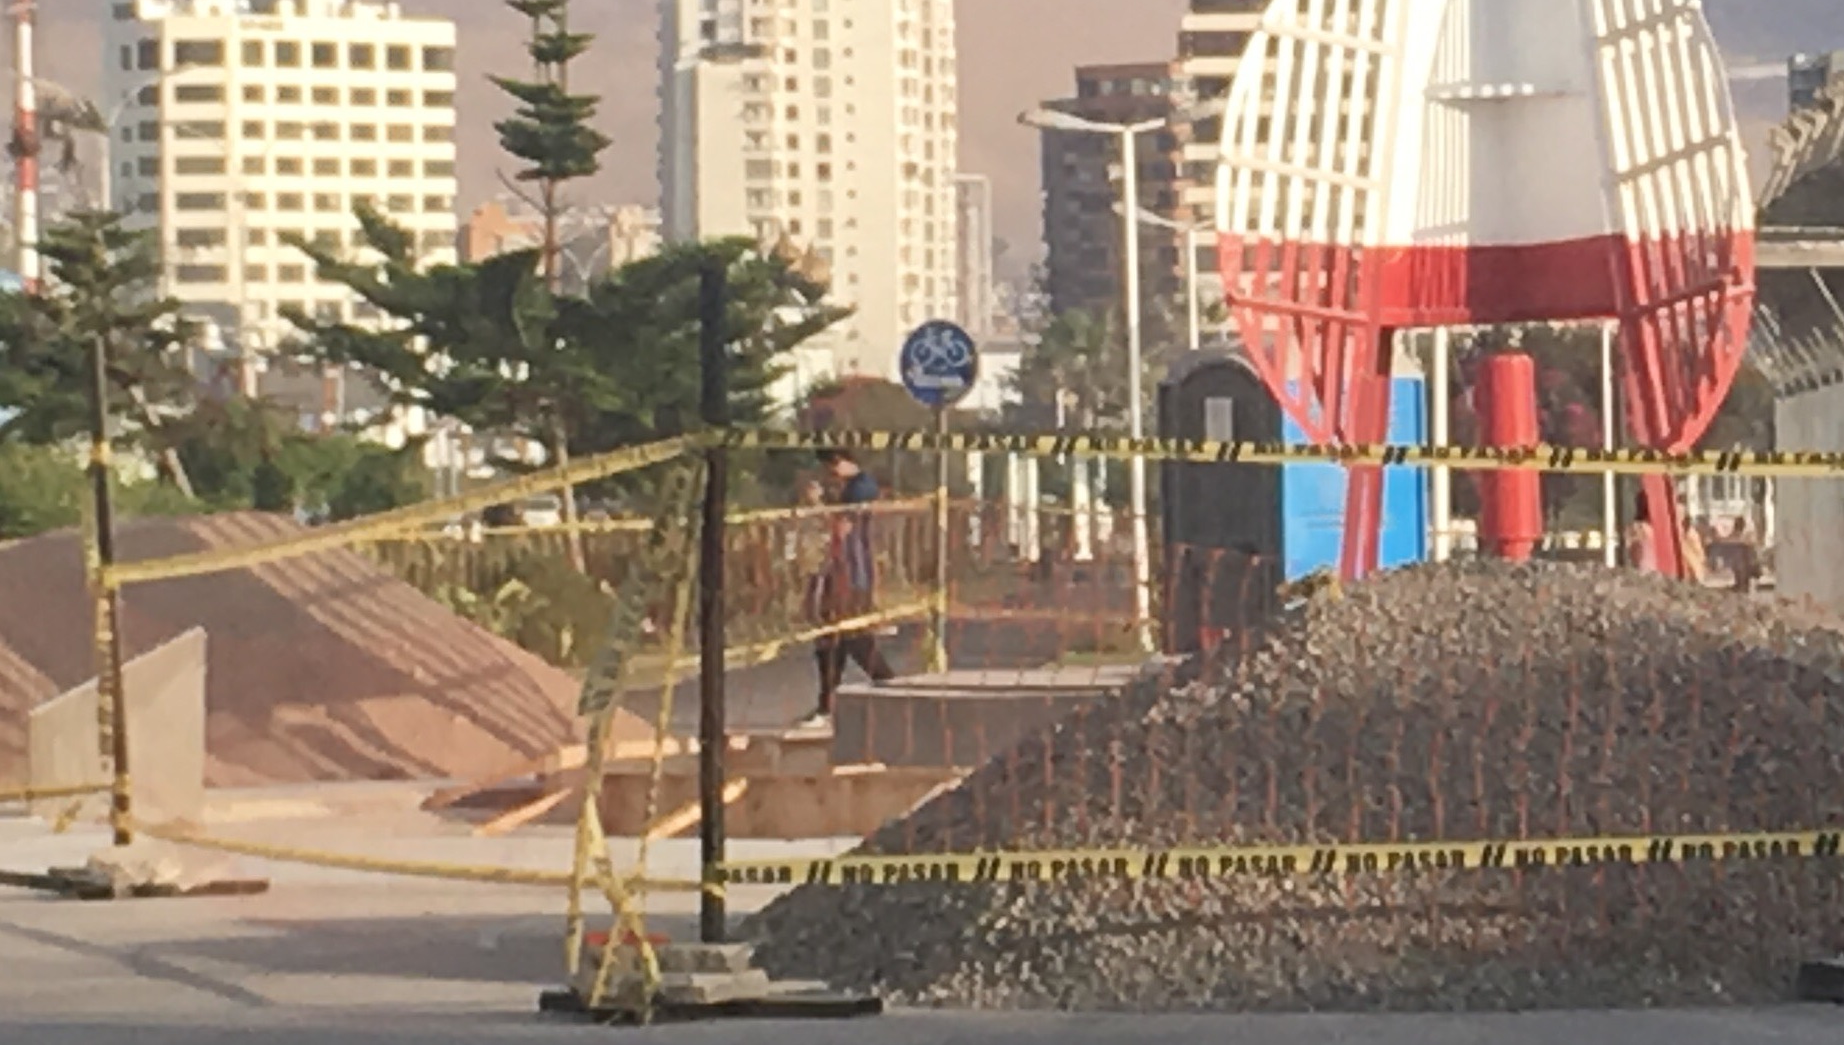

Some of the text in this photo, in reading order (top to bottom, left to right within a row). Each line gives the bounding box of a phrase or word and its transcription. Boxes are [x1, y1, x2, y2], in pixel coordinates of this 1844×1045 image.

[882, 862, 959, 882] PASAR
[1050, 858, 1128, 878] PASAR
[1219, 854, 1297, 875] PASAR
[1388, 850, 1465, 871] PASAR
[1555, 844, 1632, 865] PASAR
